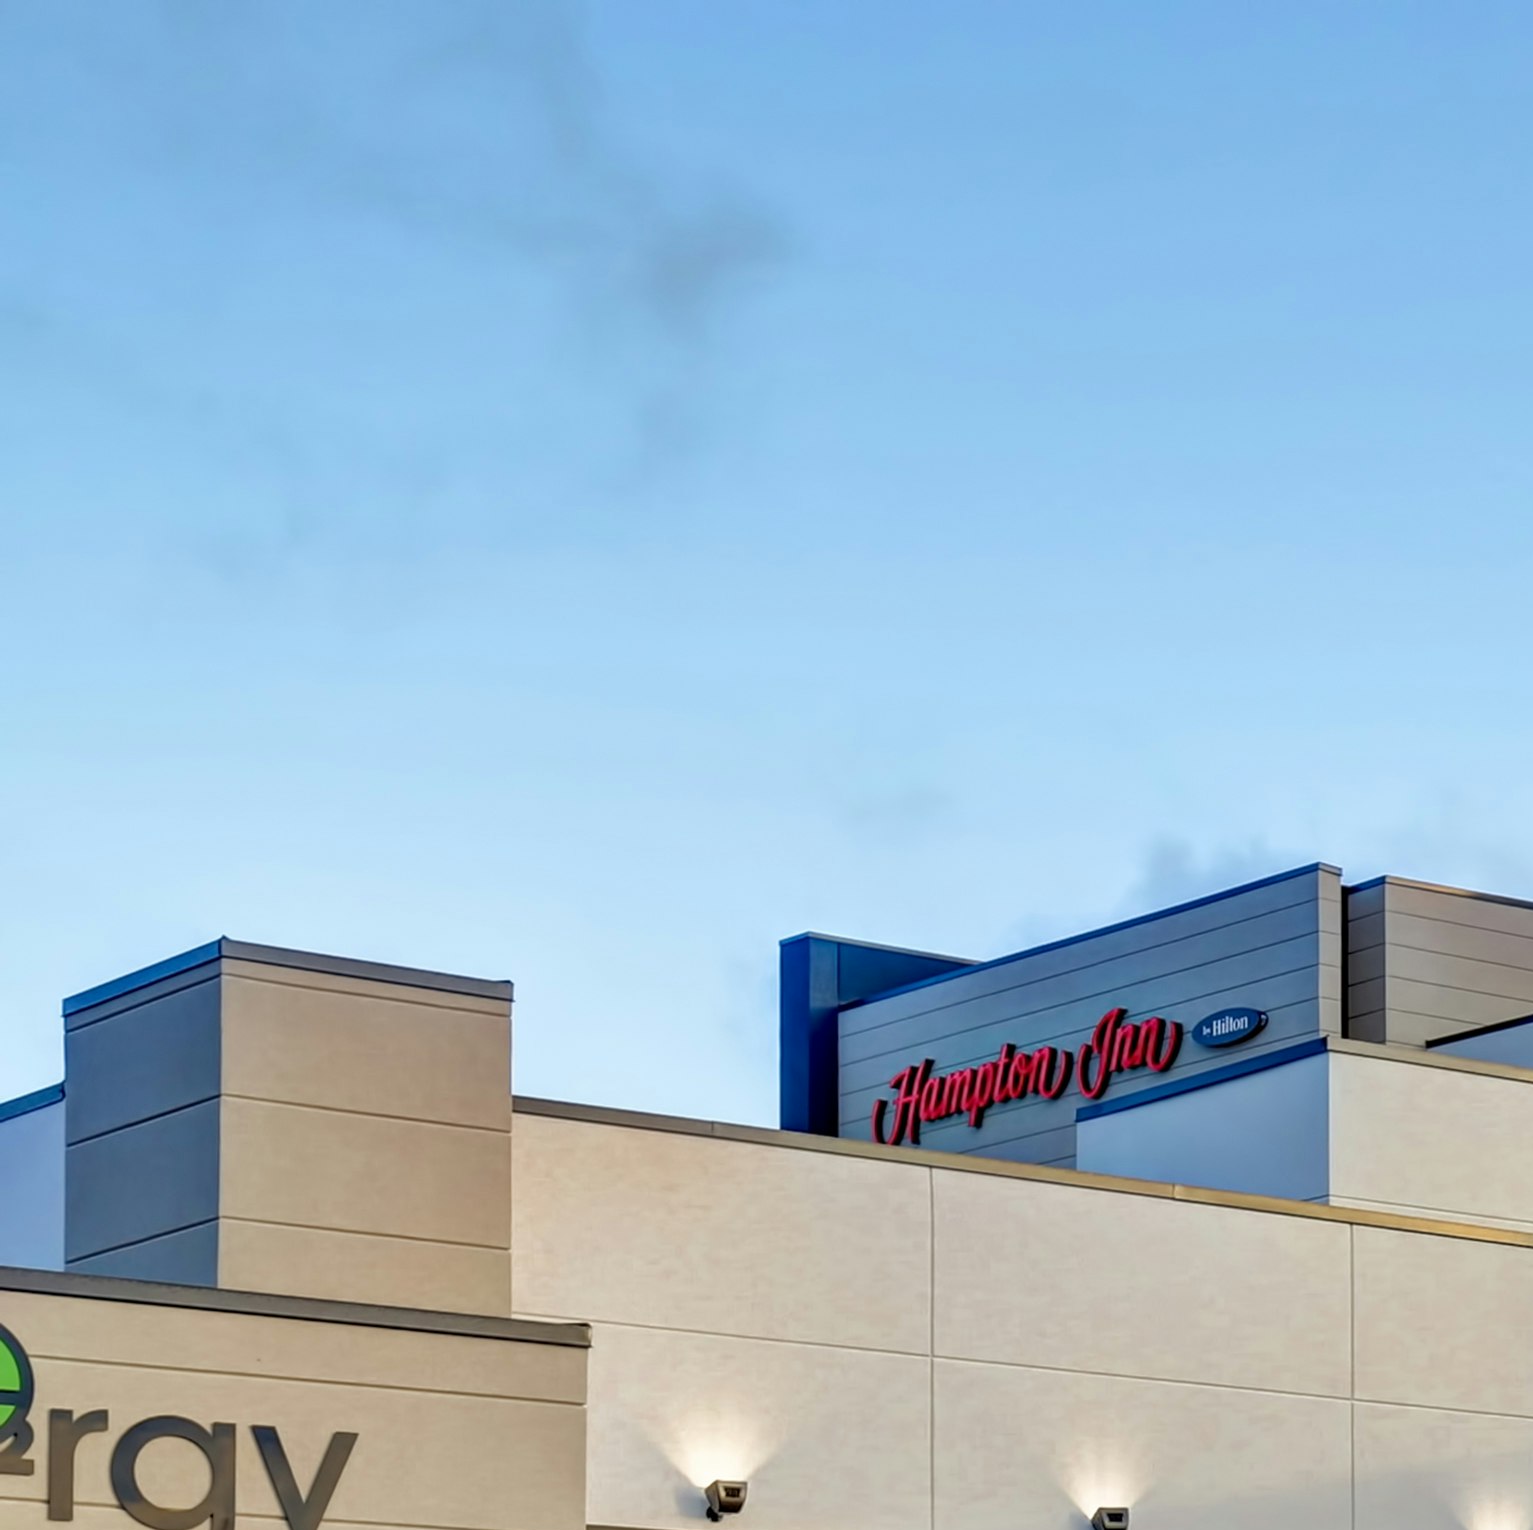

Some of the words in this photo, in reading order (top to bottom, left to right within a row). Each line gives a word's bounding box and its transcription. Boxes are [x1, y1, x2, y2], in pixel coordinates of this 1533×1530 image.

[1212, 1015, 1249, 1037] Hilton
[871, 1042, 1074, 1146] Hampton
[1076, 1007, 1183, 1099] Inn
